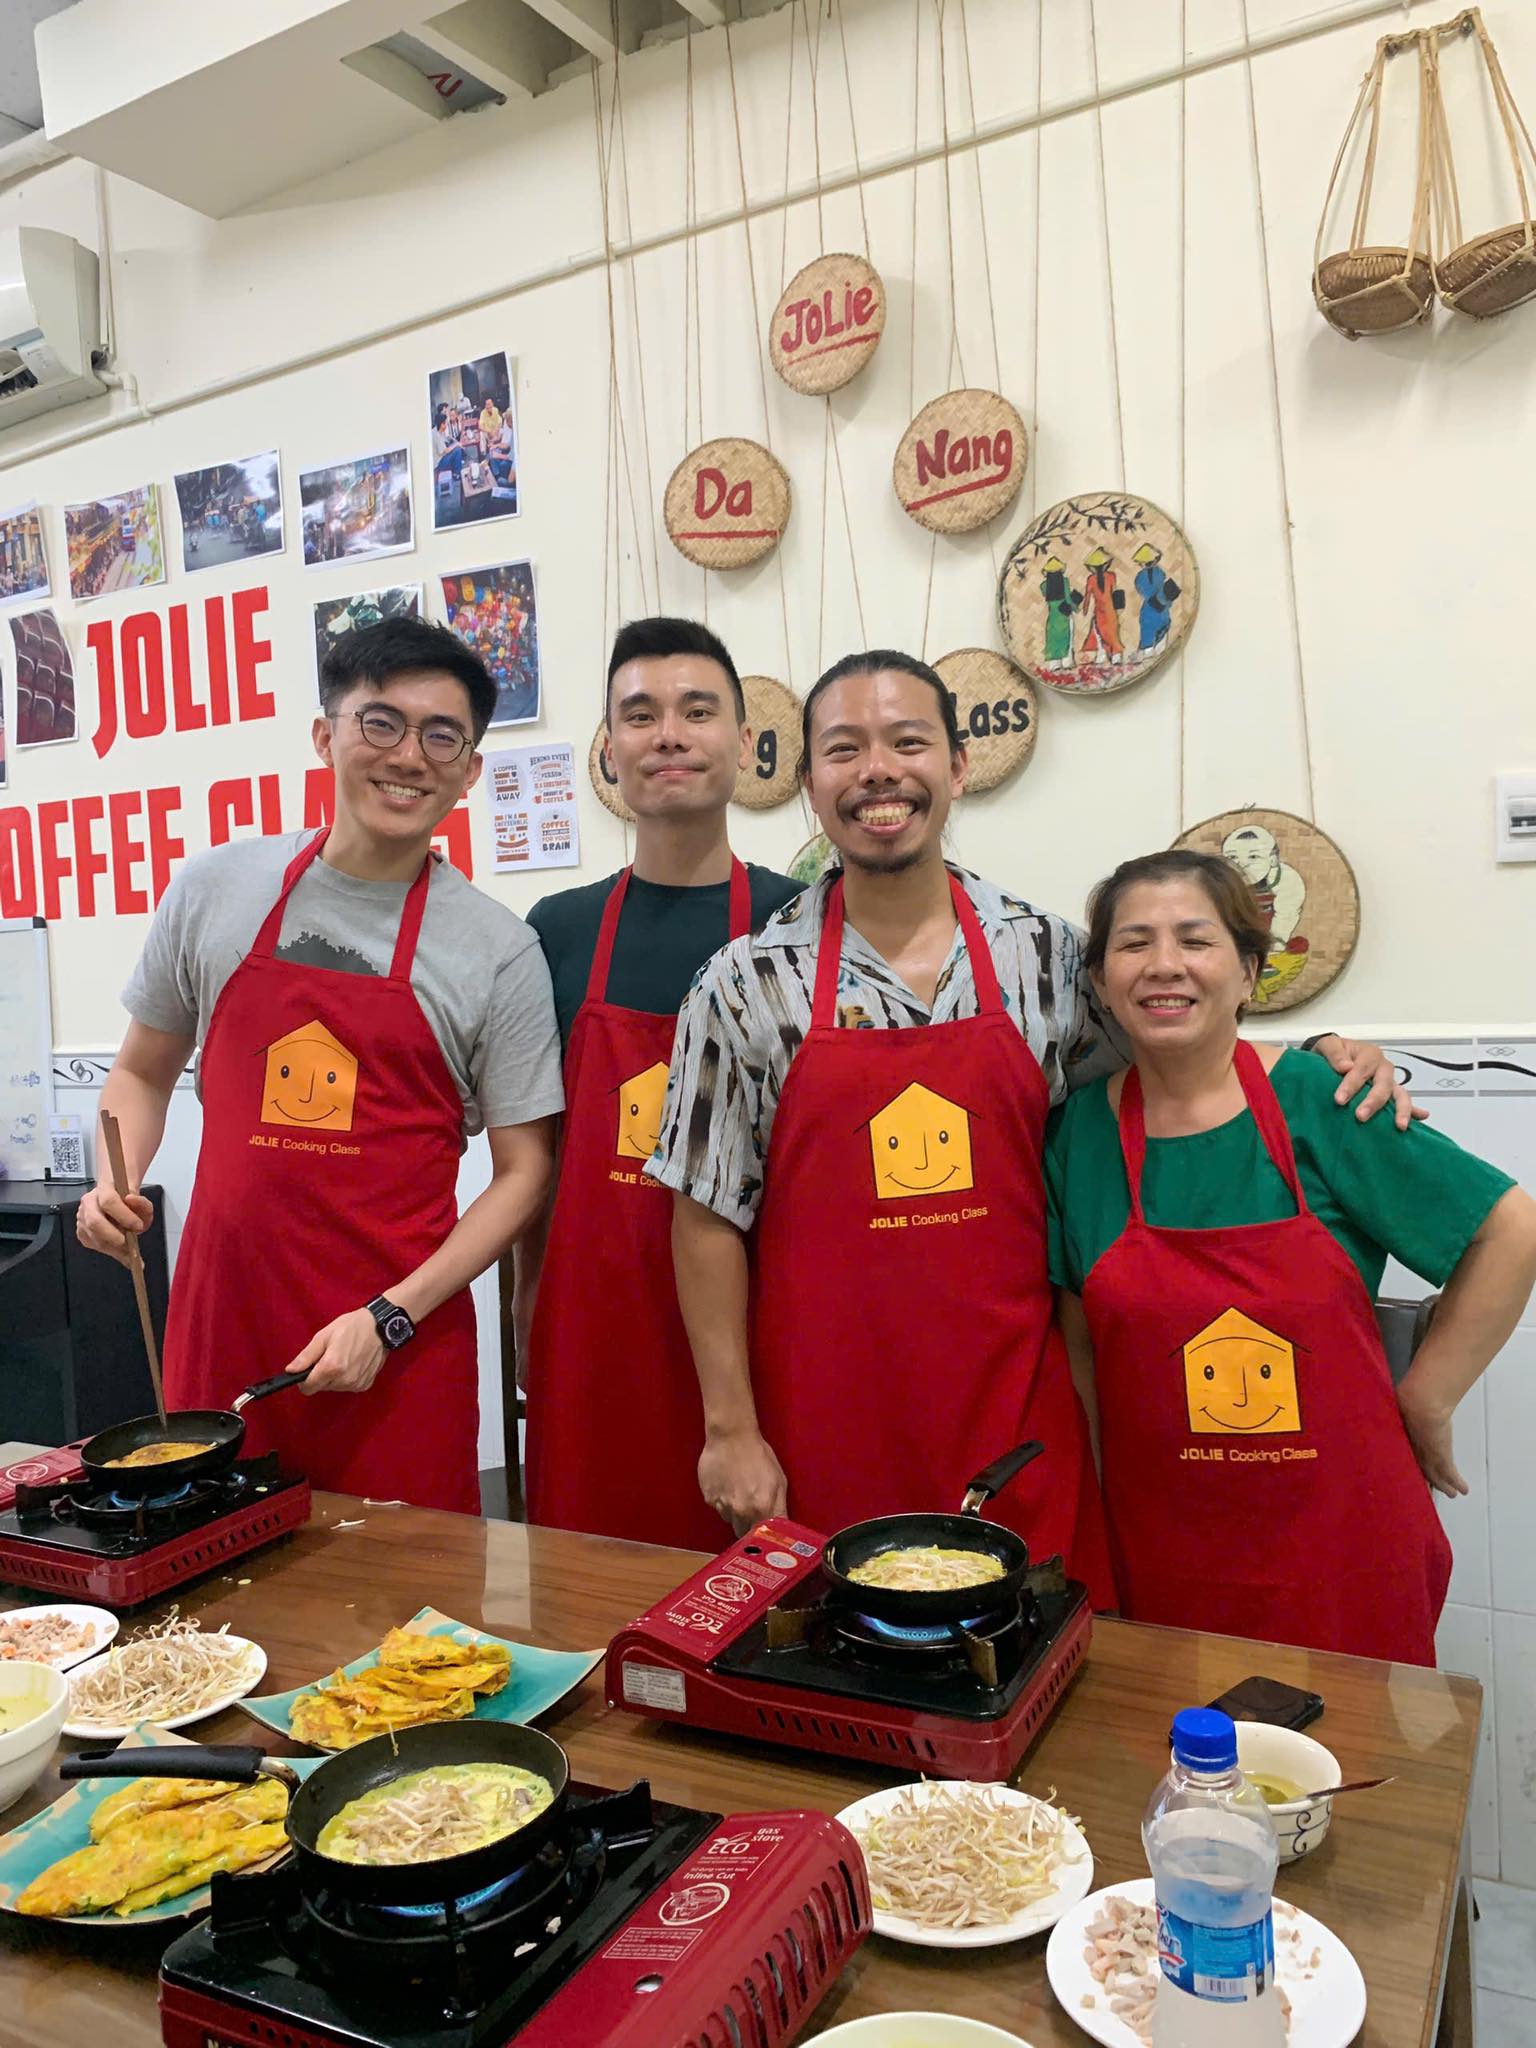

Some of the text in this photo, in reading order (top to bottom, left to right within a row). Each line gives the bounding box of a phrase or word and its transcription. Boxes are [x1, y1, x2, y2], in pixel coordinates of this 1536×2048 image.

[915, 428, 1013, 486] Nang
[694, 467, 752, 520] Da
[87, 585, 276, 759] JOLIE
[552, 753, 570, 761] EVERY
[497, 792, 520, 801] AWAY
[543, 796, 565, 804] COFFEE
[541, 820, 570, 829] COFFEE
[542, 842, 570, 851] BRAIN
[249, 1135, 360, 1155] JOLIE Cooking Class
[609, 1170, 637, 1183] JOLIE
[869, 1207, 988, 1229] JOLIE Cooking Class
[1179, 1448, 1318, 1463] JOLIE Cooking Class
[691, 1611, 725, 1631] ECO
[751, 1834, 784, 1843] stove
[757, 1828, 781, 1836] gas
[707, 1842, 750, 1855] ECO
[683, 1871, 737, 1880] Inline Cut
